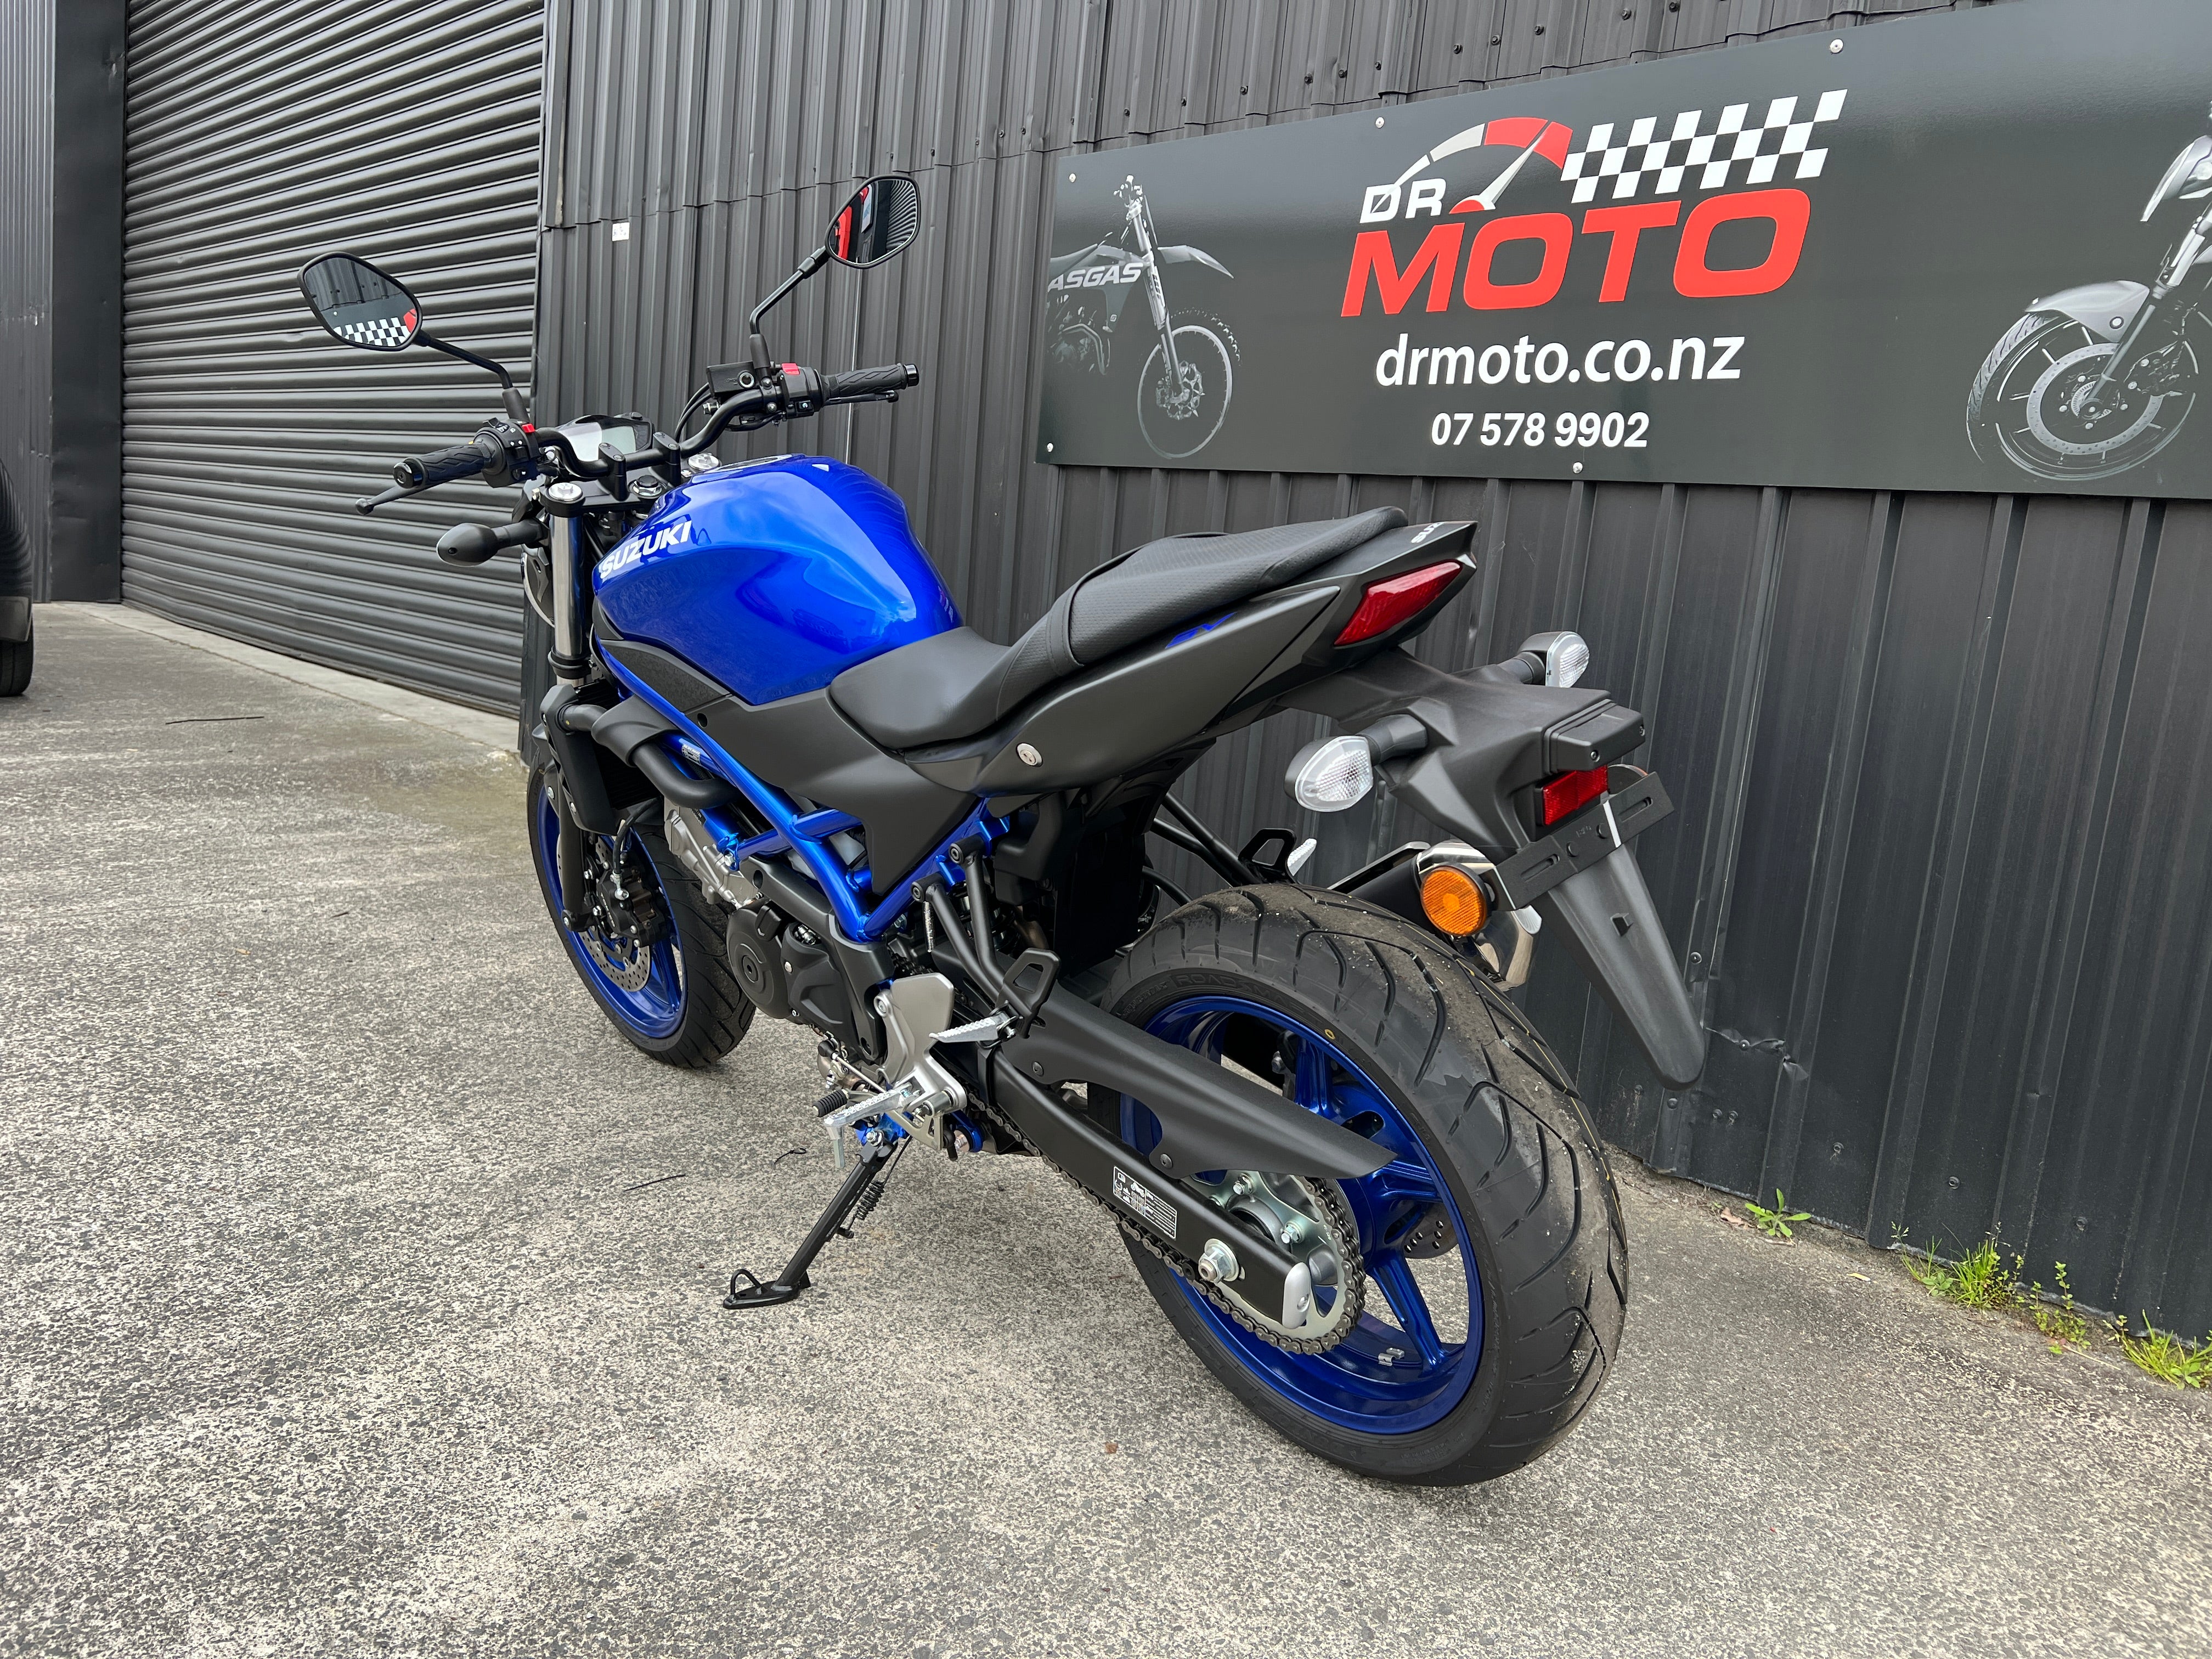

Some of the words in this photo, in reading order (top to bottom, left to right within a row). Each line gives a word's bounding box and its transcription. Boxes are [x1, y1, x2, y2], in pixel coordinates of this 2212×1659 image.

[1359, 178, 1447, 224] DR
[1341, 188, 1810, 317] MOTO
[1375, 332, 1746, 386] drmoto.co.nz
[1431, 412, 1474, 446] 07
[1479, 411, 1546, 447] 578
[1554, 411, 1649, 448] 9902
[600, 521, 692, 579] SUZUKI
[1410, 522, 1445, 544] SUZ
